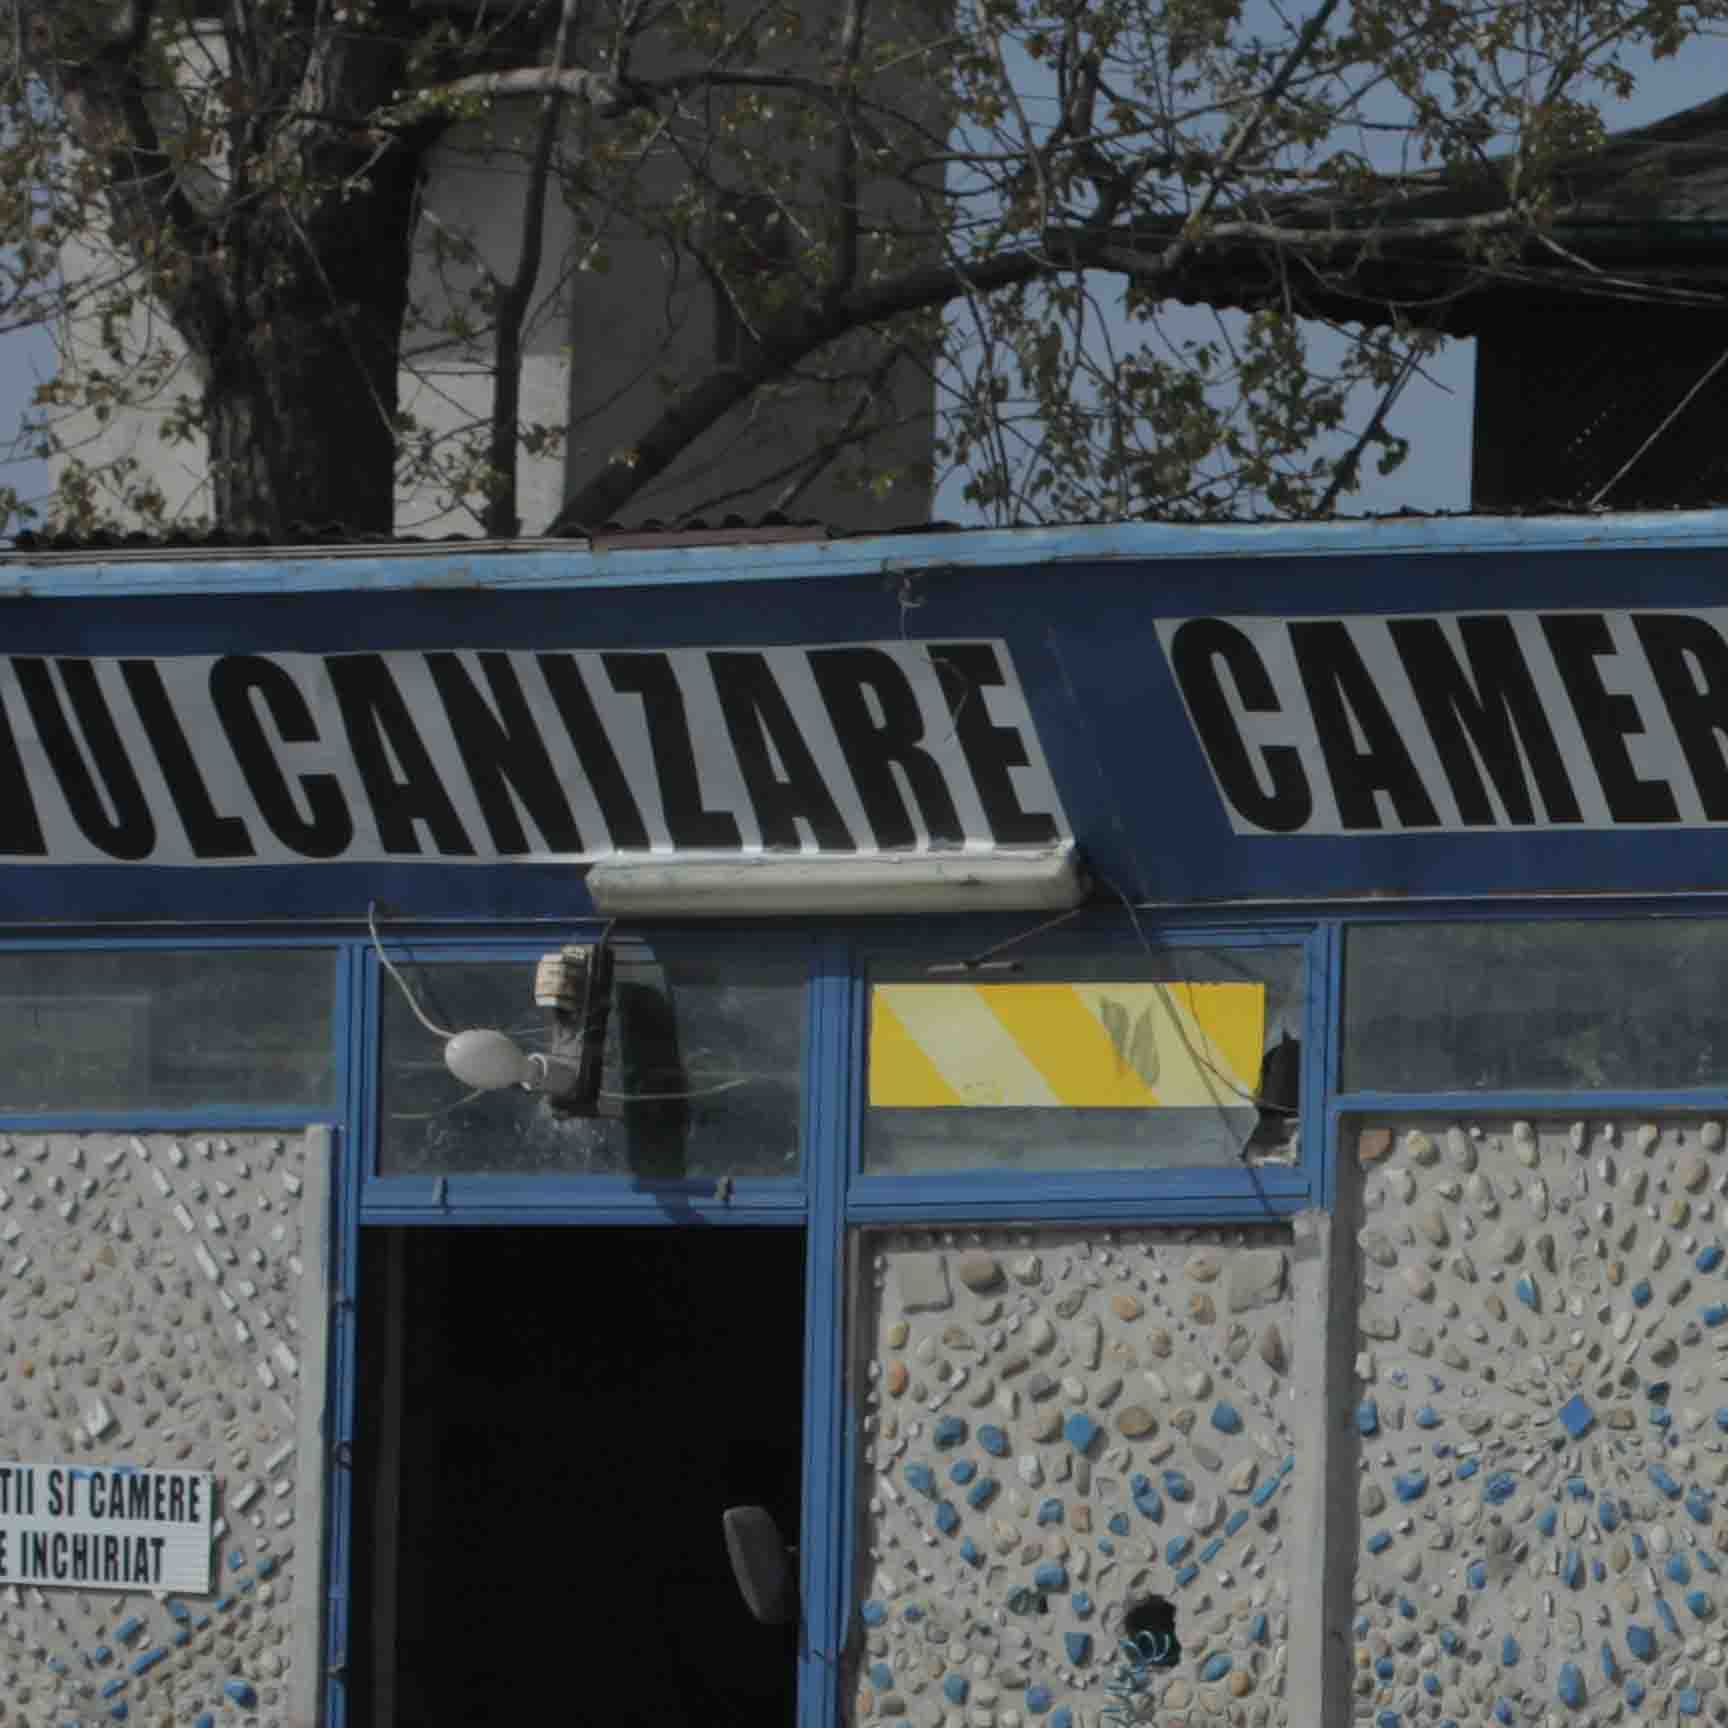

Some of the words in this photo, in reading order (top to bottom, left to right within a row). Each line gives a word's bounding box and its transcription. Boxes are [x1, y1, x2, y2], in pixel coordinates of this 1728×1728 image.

[48, 1469, 76, 1518] SI
[89, 1471, 200, 1523] CAMERE
[20, 1531, 165, 1583] INCHIRIAT
